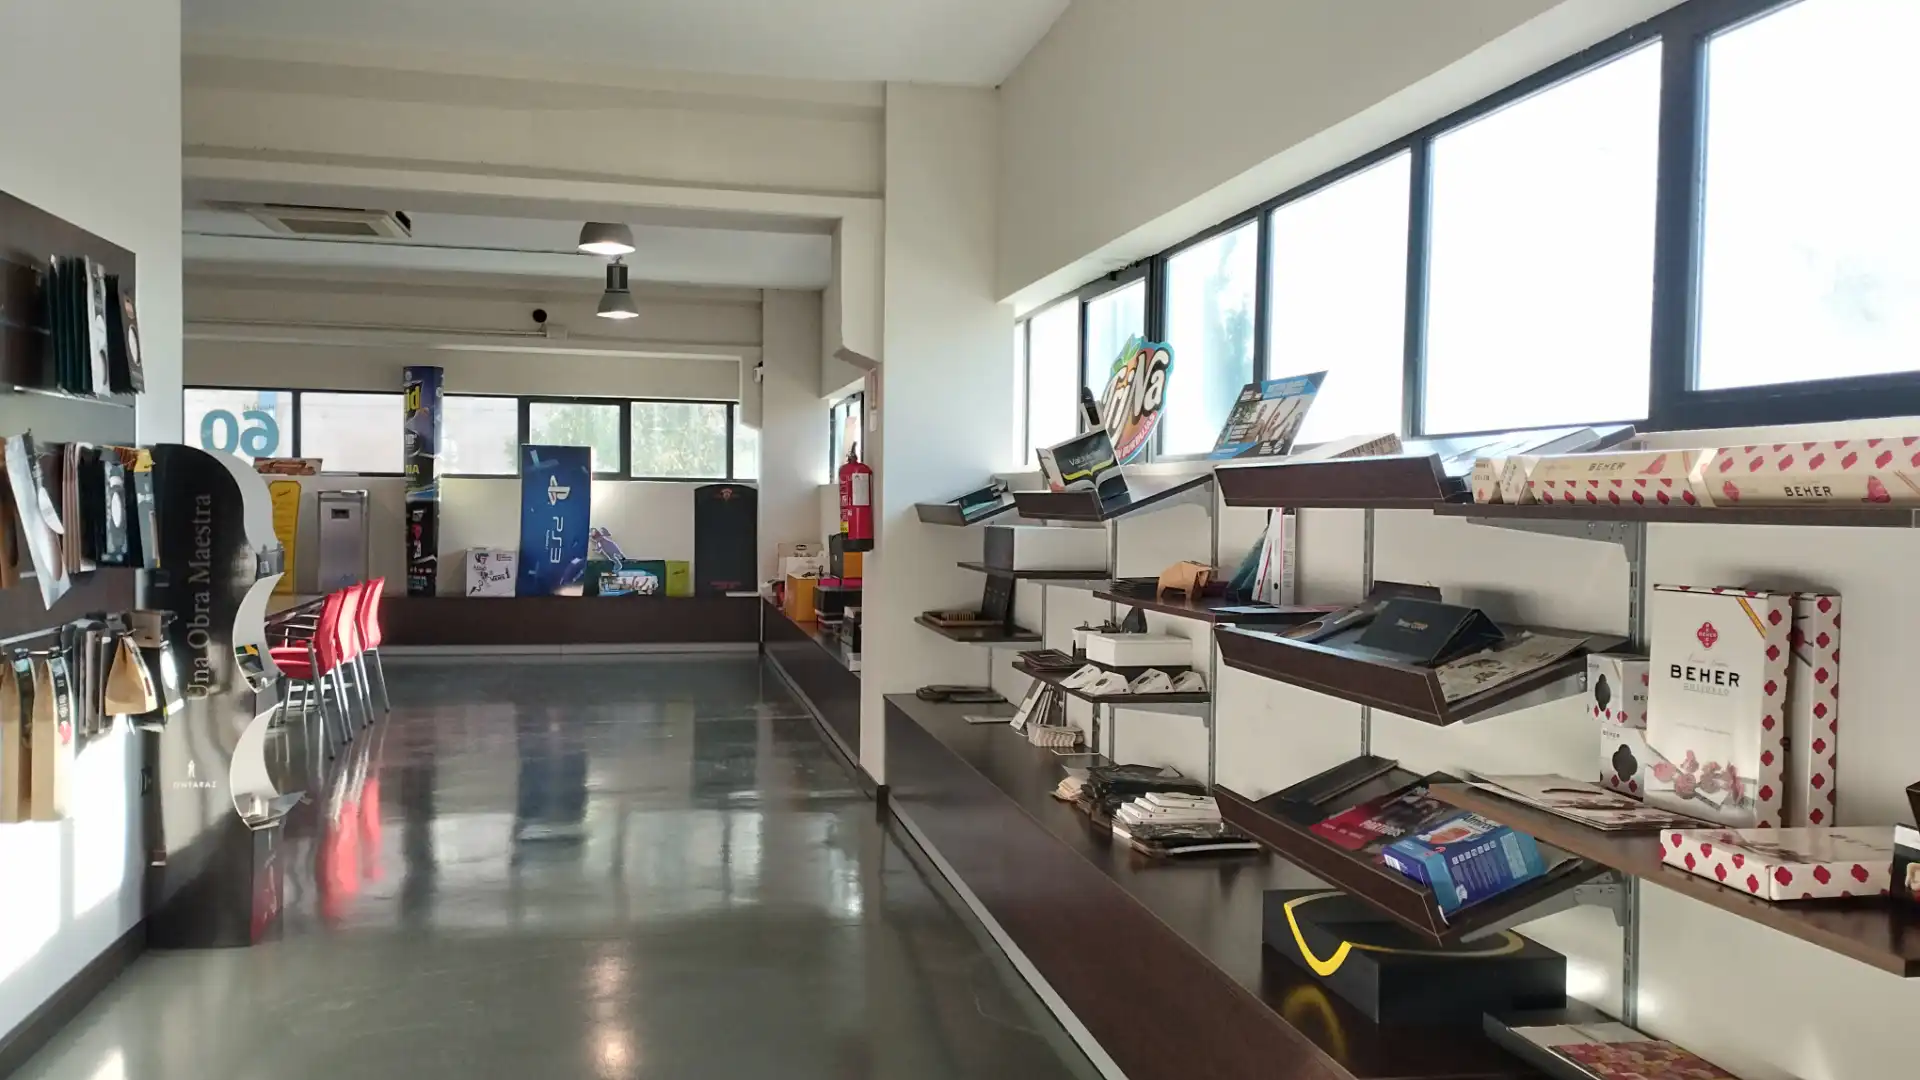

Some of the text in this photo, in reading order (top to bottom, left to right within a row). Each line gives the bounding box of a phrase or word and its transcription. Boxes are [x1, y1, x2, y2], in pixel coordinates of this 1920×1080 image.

[1784, 486, 1833, 498] BEHER
[550, 516, 564, 564] PS3
[186, 494, 212, 701] Una Obra Maestra
[1670, 664, 1741, 688] BEHER
